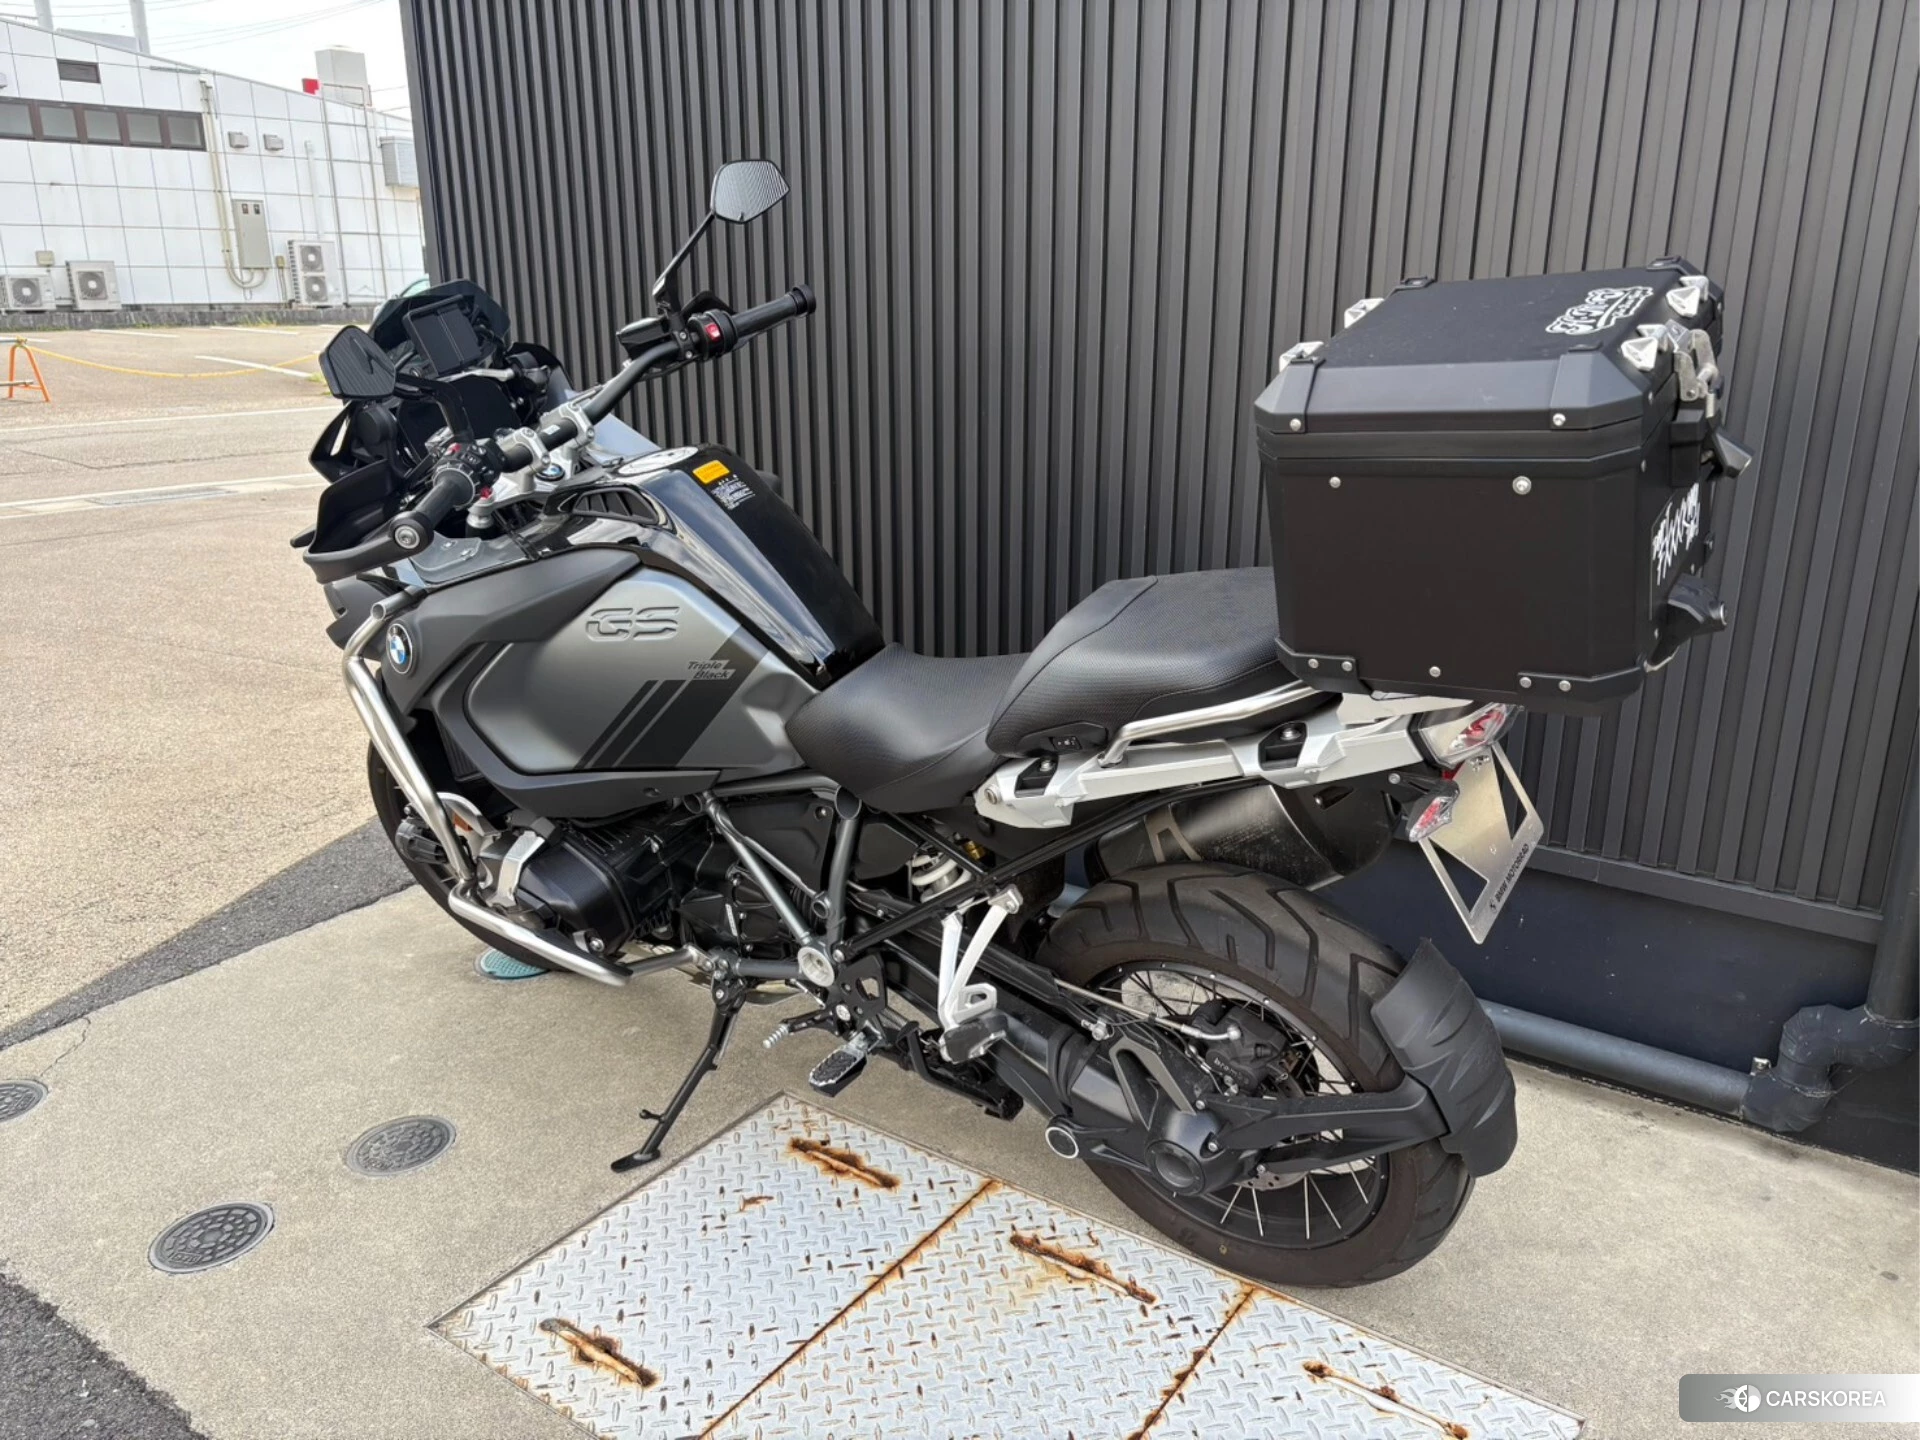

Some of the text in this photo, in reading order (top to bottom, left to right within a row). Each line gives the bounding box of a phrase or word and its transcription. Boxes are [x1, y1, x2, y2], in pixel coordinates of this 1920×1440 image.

[585, 606, 680, 642] GS
[687, 660, 723, 671] Triple
[694, 670, 730, 679] Black
[1495, 880, 1508, 902] BMW
